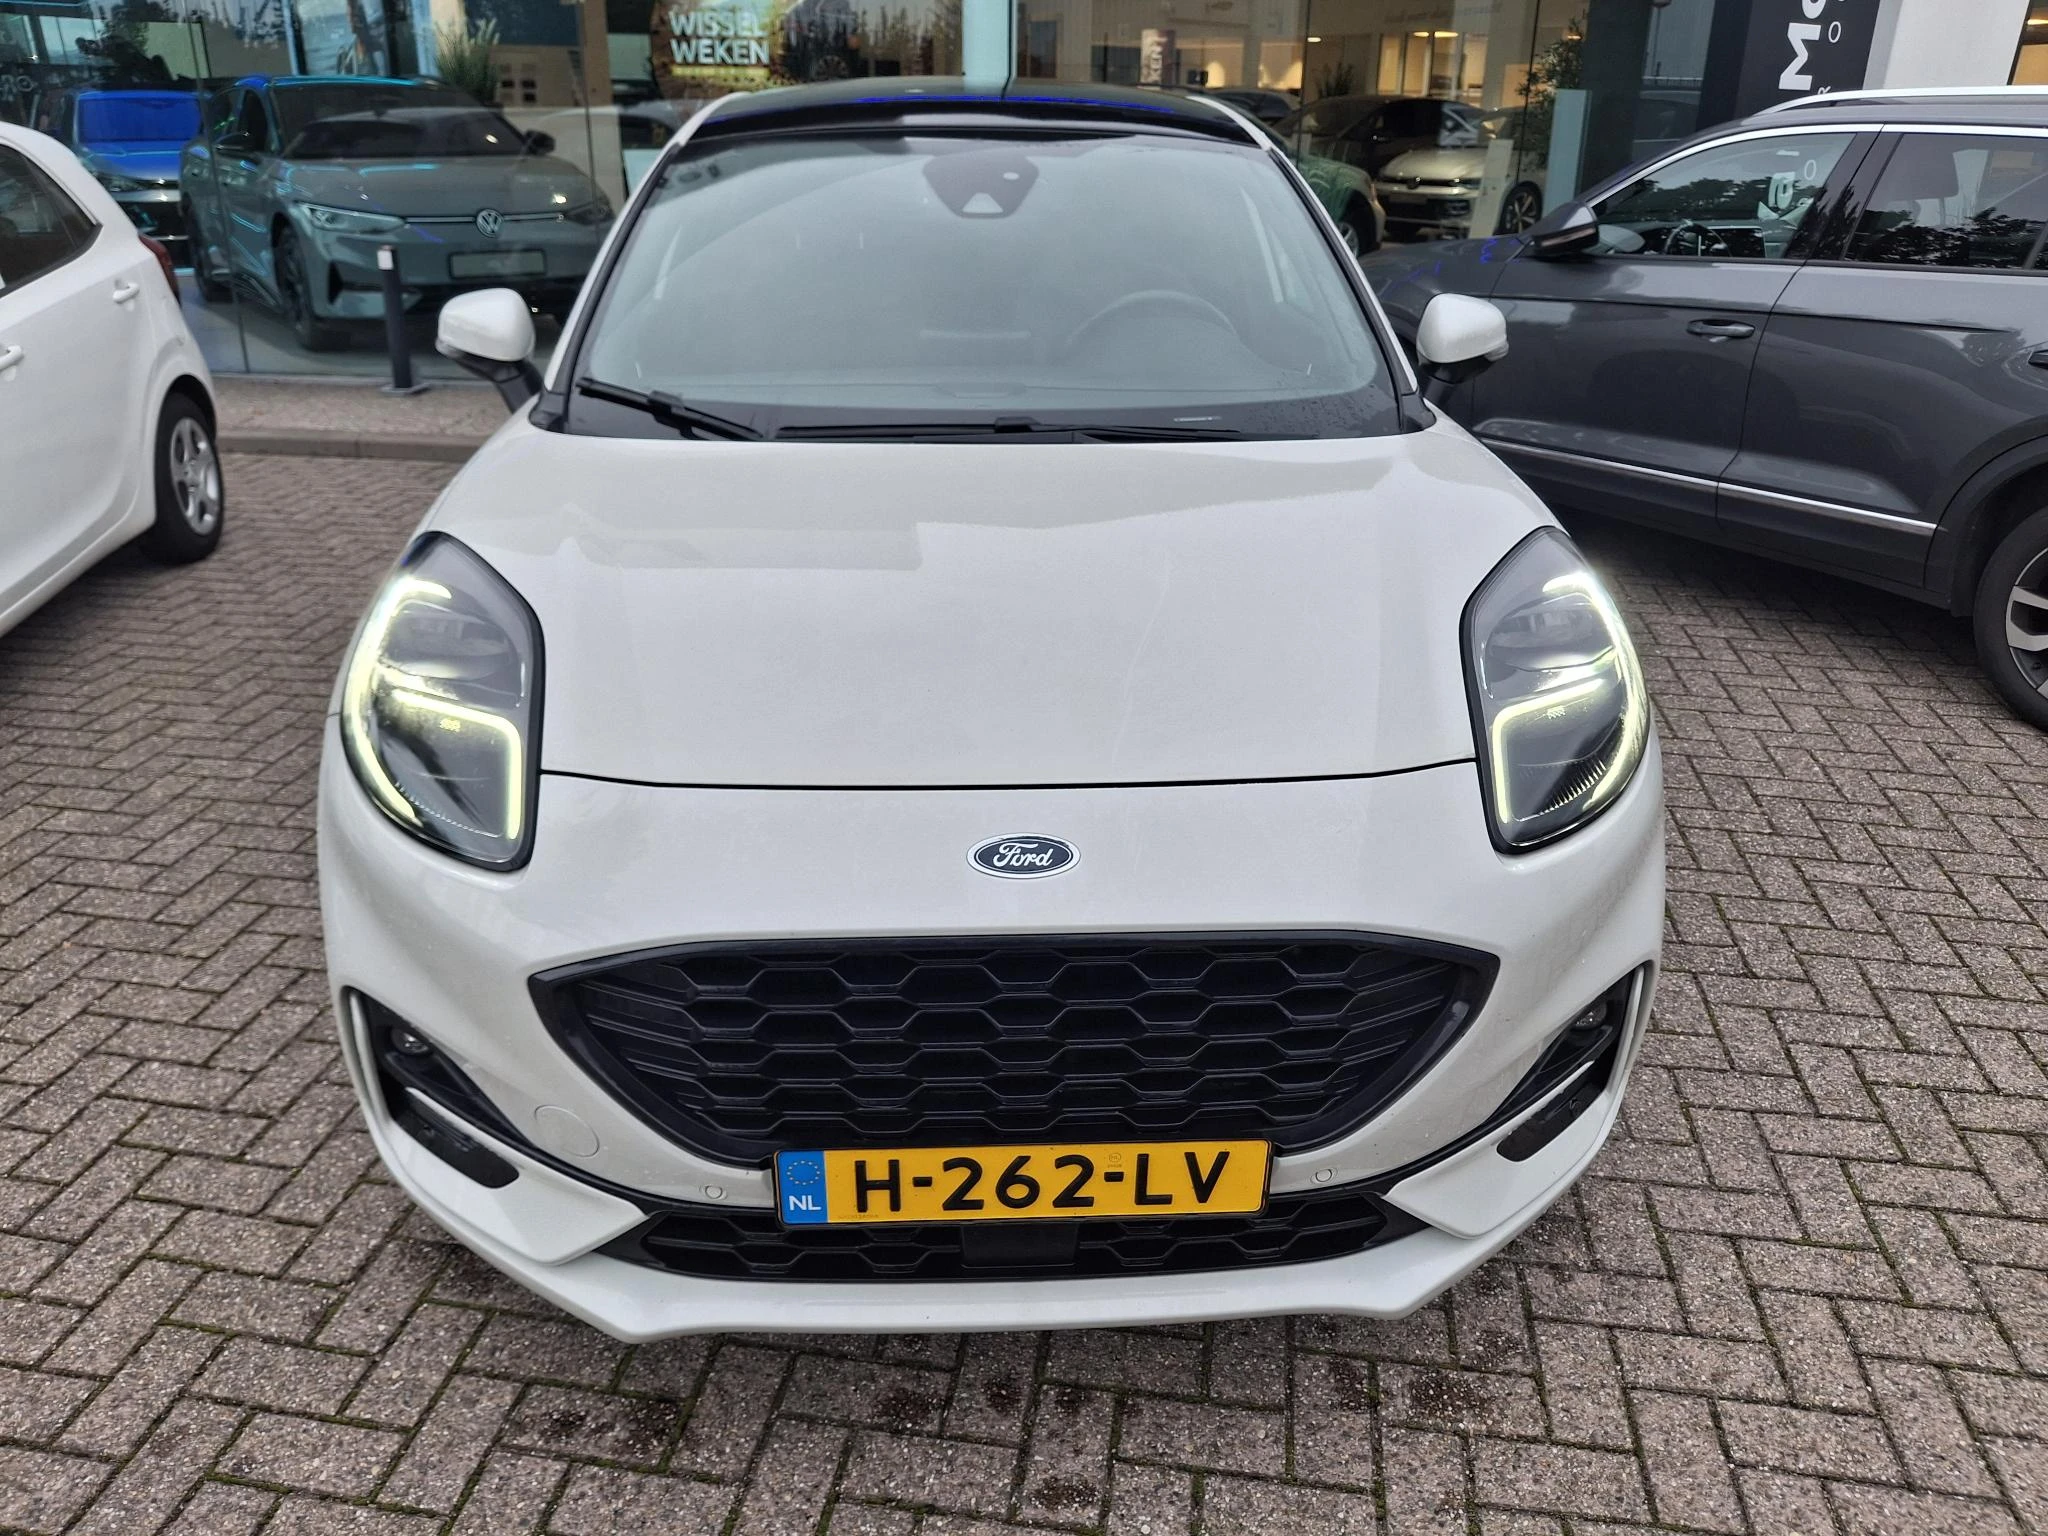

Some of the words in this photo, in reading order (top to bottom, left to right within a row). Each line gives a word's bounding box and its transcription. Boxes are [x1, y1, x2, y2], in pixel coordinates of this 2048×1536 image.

[668, 10, 768, 37] WISSEL
[670, 39, 770, 65] WEKEN
[992, 842, 1054, 868] Ford
[788, 1195, 822, 1211] NL
[854, 1151, 1231, 1213] H-262-LV
